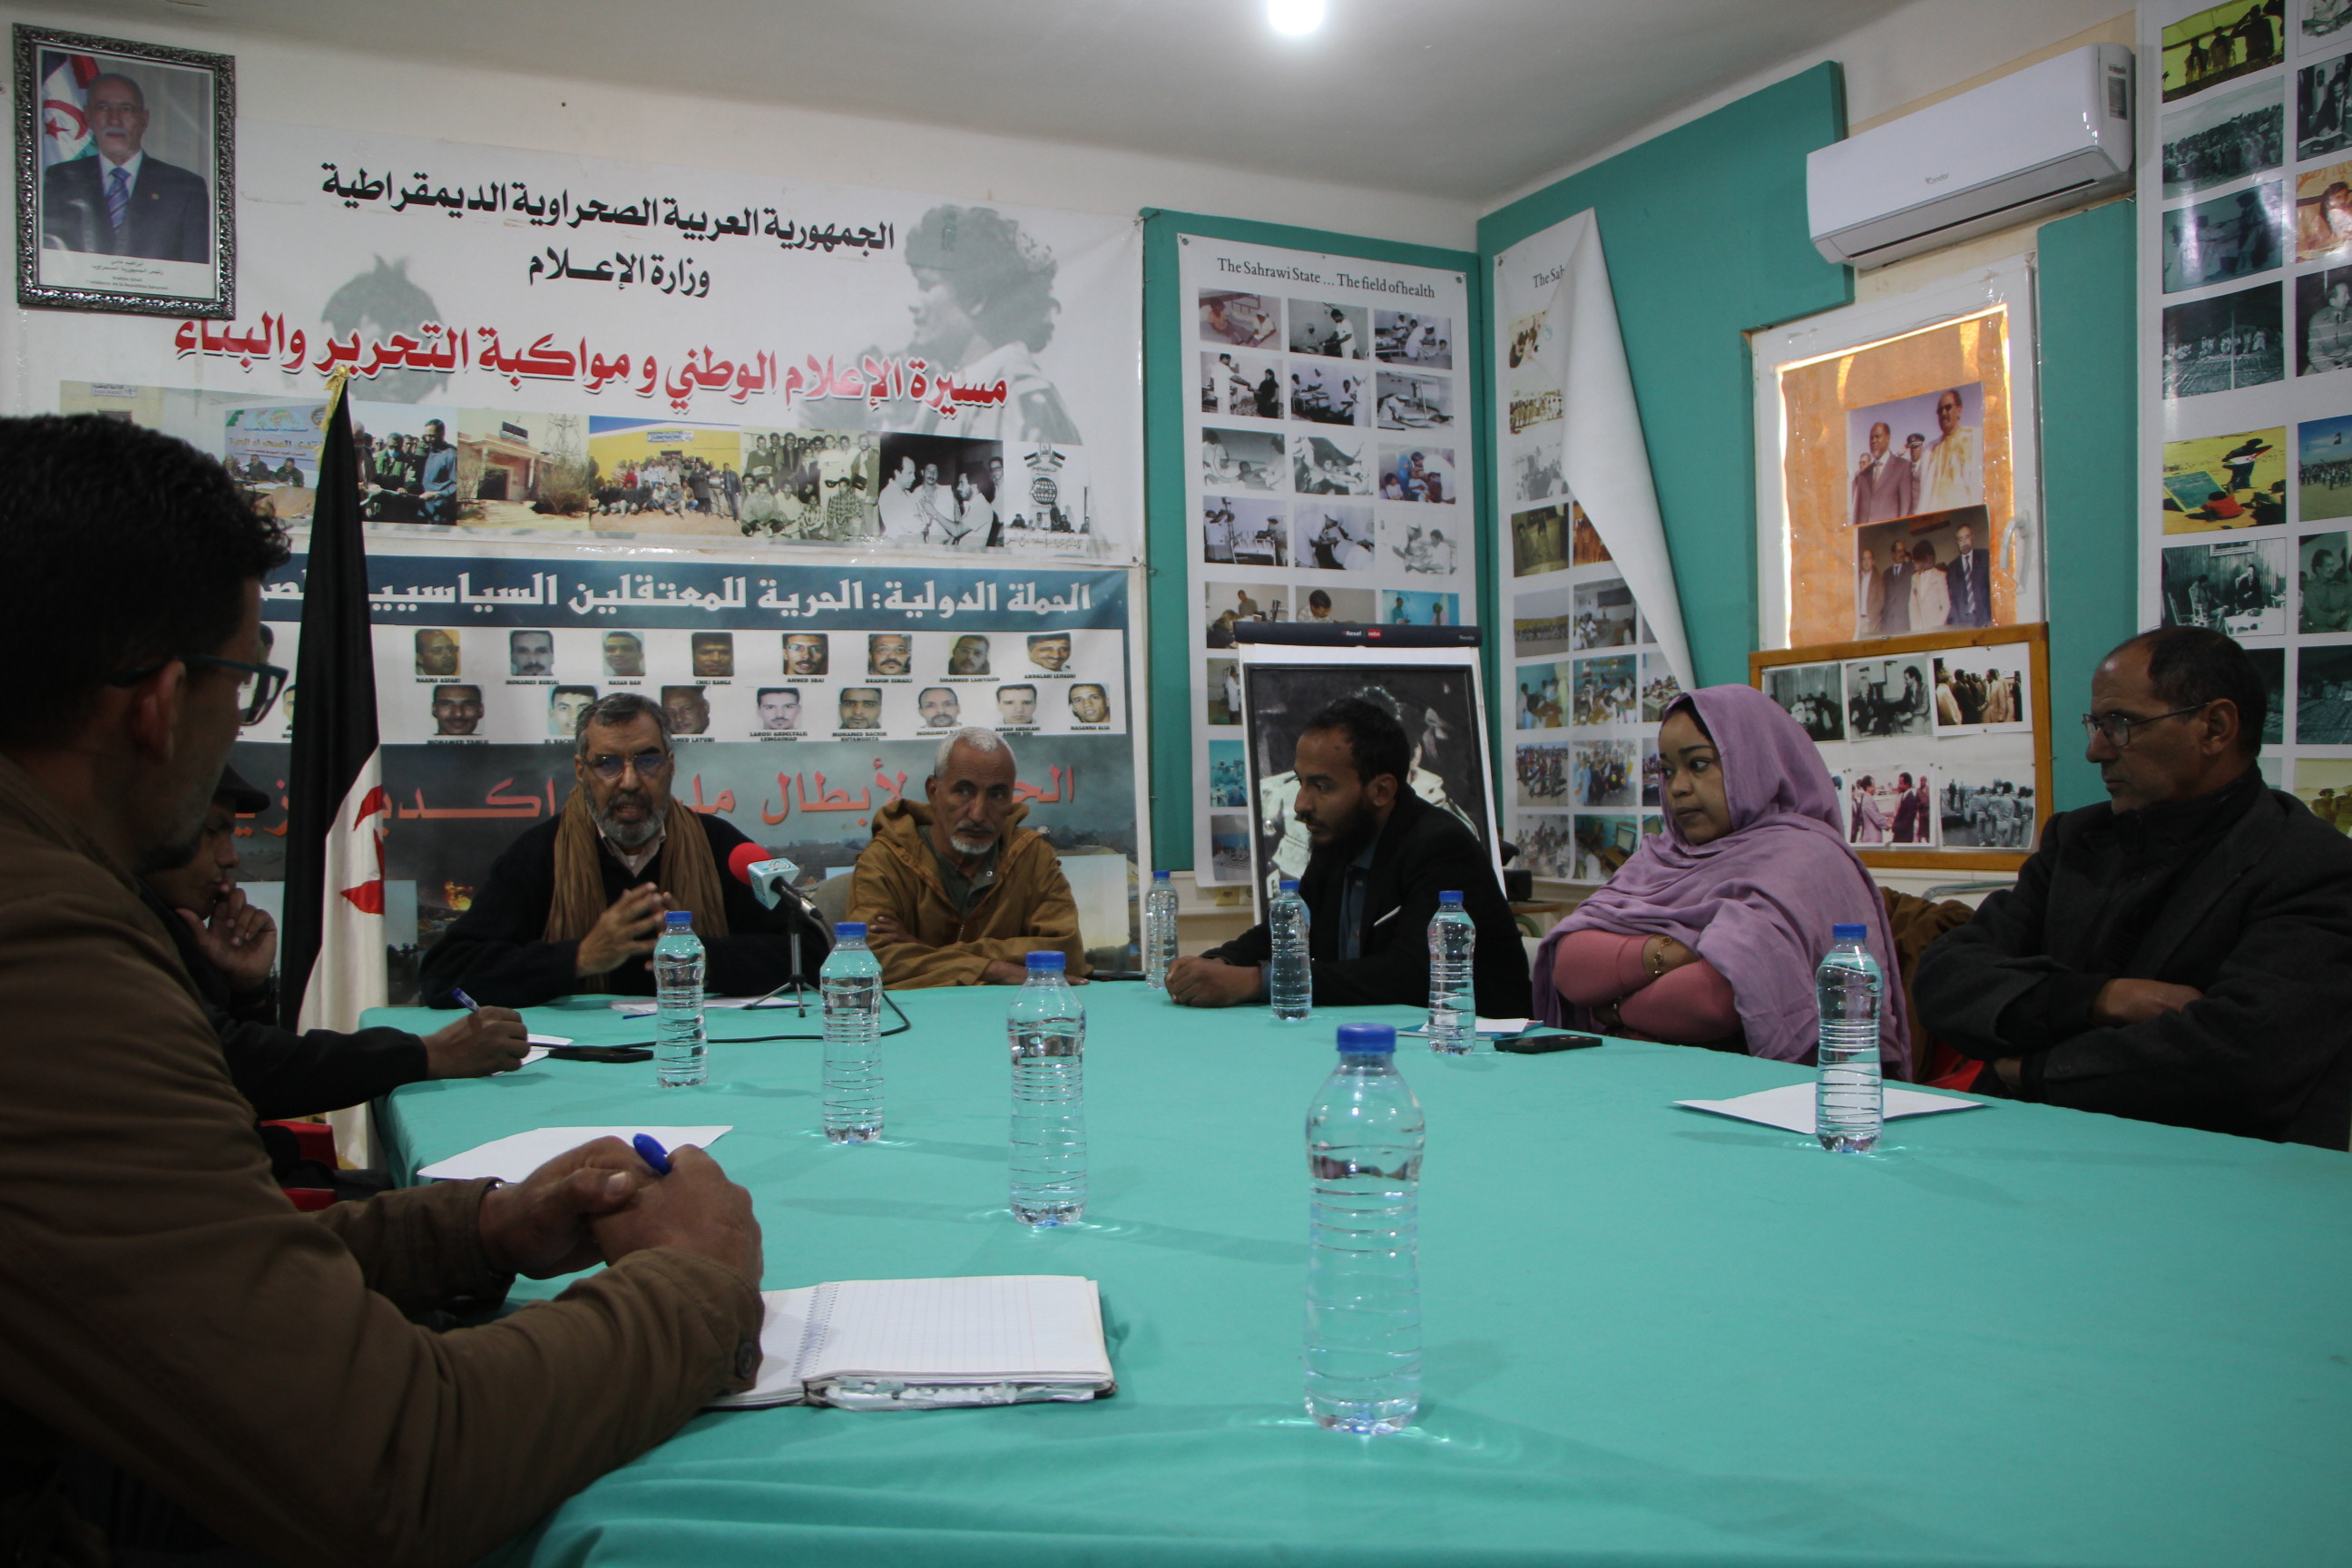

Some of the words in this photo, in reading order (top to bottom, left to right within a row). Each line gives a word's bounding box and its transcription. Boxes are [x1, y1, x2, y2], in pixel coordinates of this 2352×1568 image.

[321, 162, 507, 219] الديمقراطية
[511, 181, 659, 230] الصحراوية
[662, 197, 760, 242] العربية
[763, 207, 895, 251] الجمهورية
[529, 247, 645, 291] الإعلام
[651, 254, 710, 298] وزارة
[1217, 258, 1242, 273] The
[1243, 260, 1290, 279] Sahrawi
[1292, 267, 1321, 283] State
[1337, 273, 1360, 289] The
[1361, 276, 1387, 292] field
[1533, 272, 1550, 289] The
[314, 324, 470, 377] التحرير
[478, 327, 632, 390] مواكبة
[665, 347, 778, 411] الوطني
[908, 361, 1008, 416] مسيرة
[368, 571, 559, 612] السياسيي
[567, 573, 748, 616] للمعتقلين
[757, 577, 865, 618] الحرية
[1007, 581, 1092, 616] الحملة
